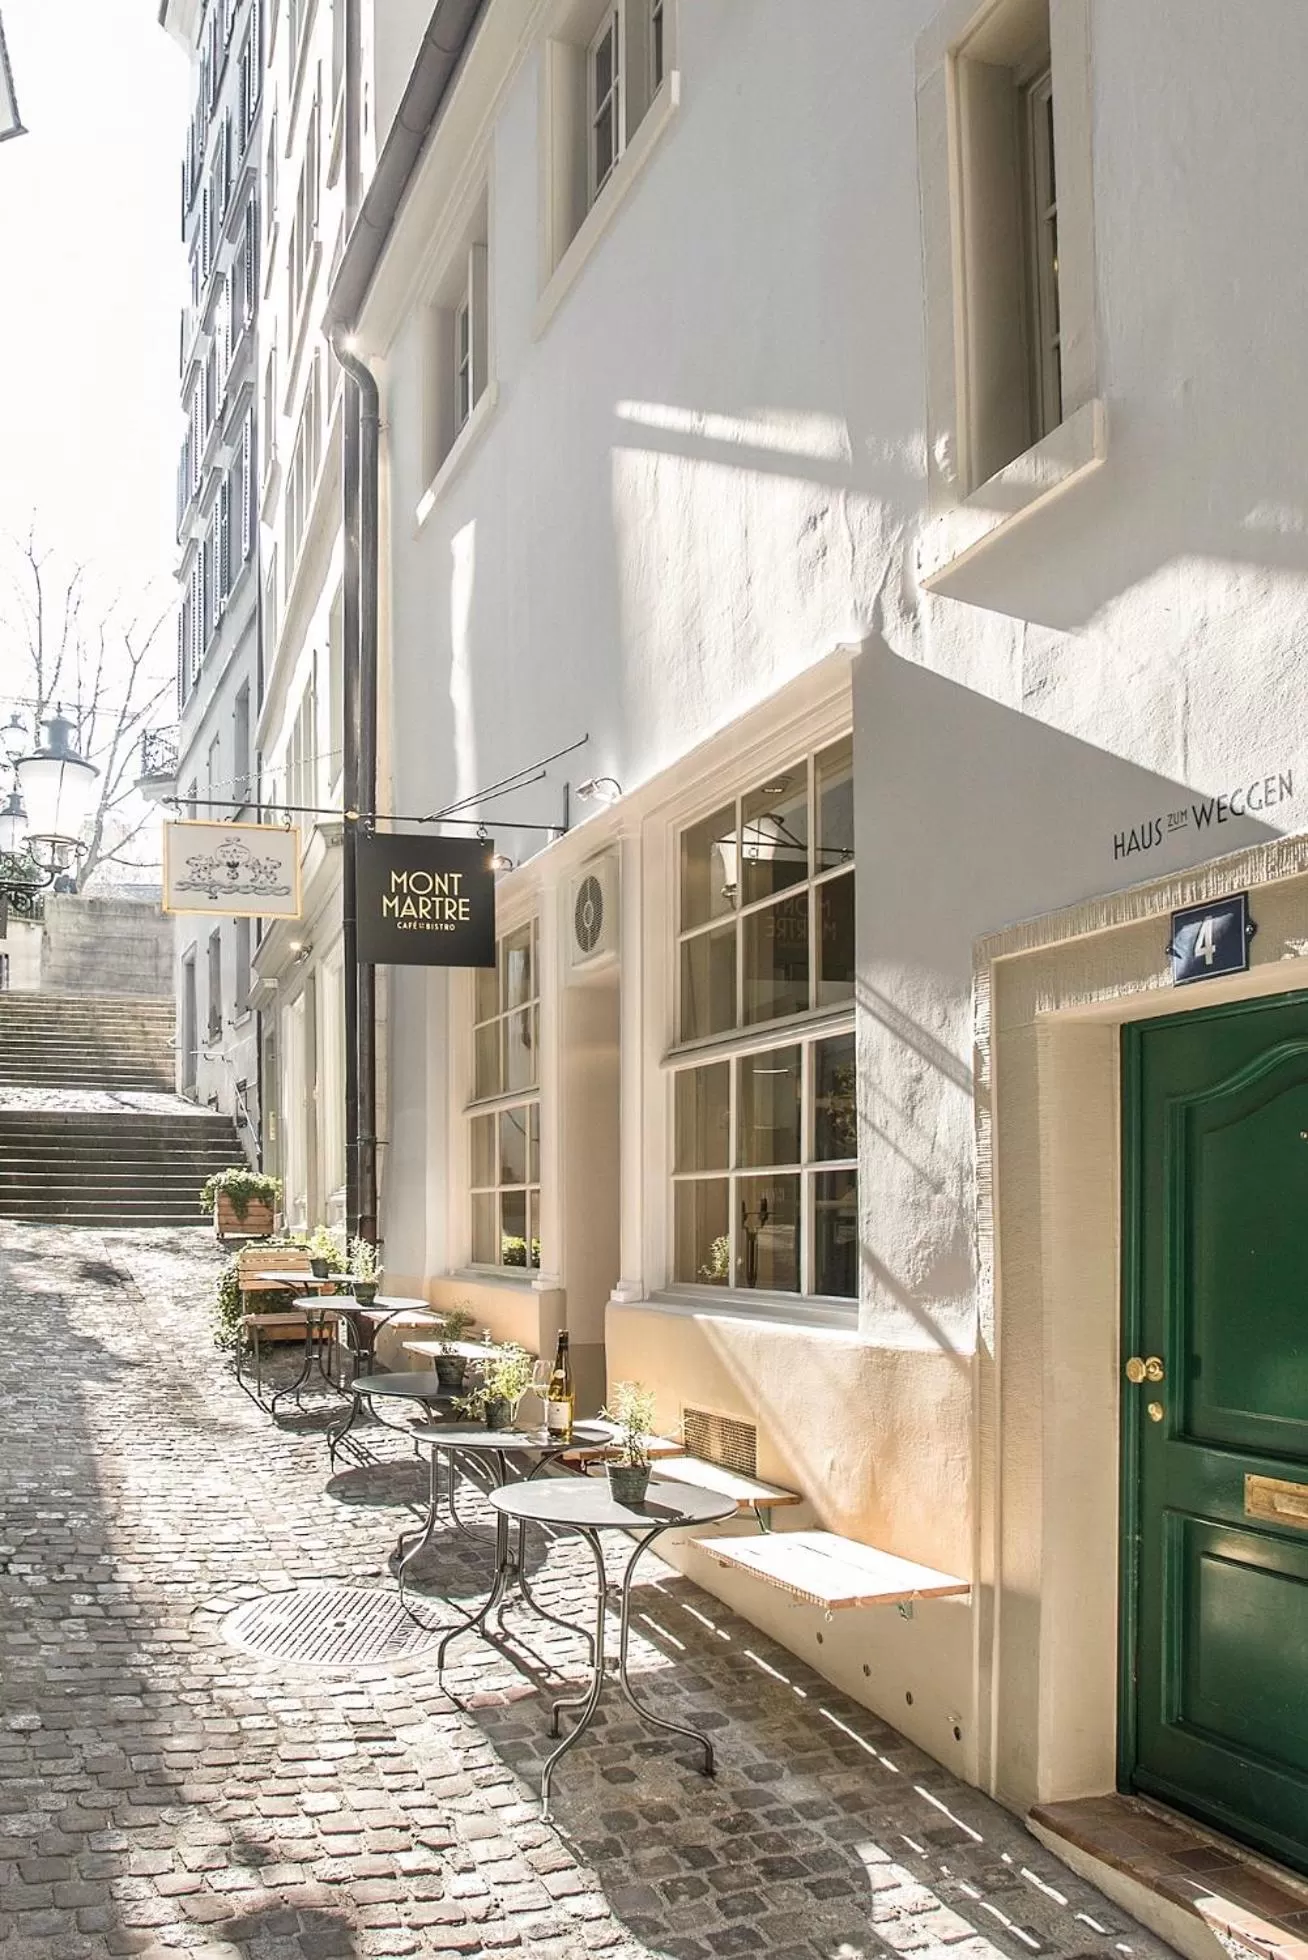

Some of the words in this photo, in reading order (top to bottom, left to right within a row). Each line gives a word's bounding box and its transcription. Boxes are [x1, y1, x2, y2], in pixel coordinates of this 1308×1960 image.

[1113, 817, 1162, 860] HAUS
[1167, 809, 1188, 827] ZUM
[1192, 769, 1293, 831] WEGGEN
[391, 871, 463, 896] MONT
[382, 895, 470, 921] MARTRE
[397, 921, 418, 930] CAFÉ
[425, 923, 456, 931] BISTRO
[1194, 915, 1216, 965] 4
